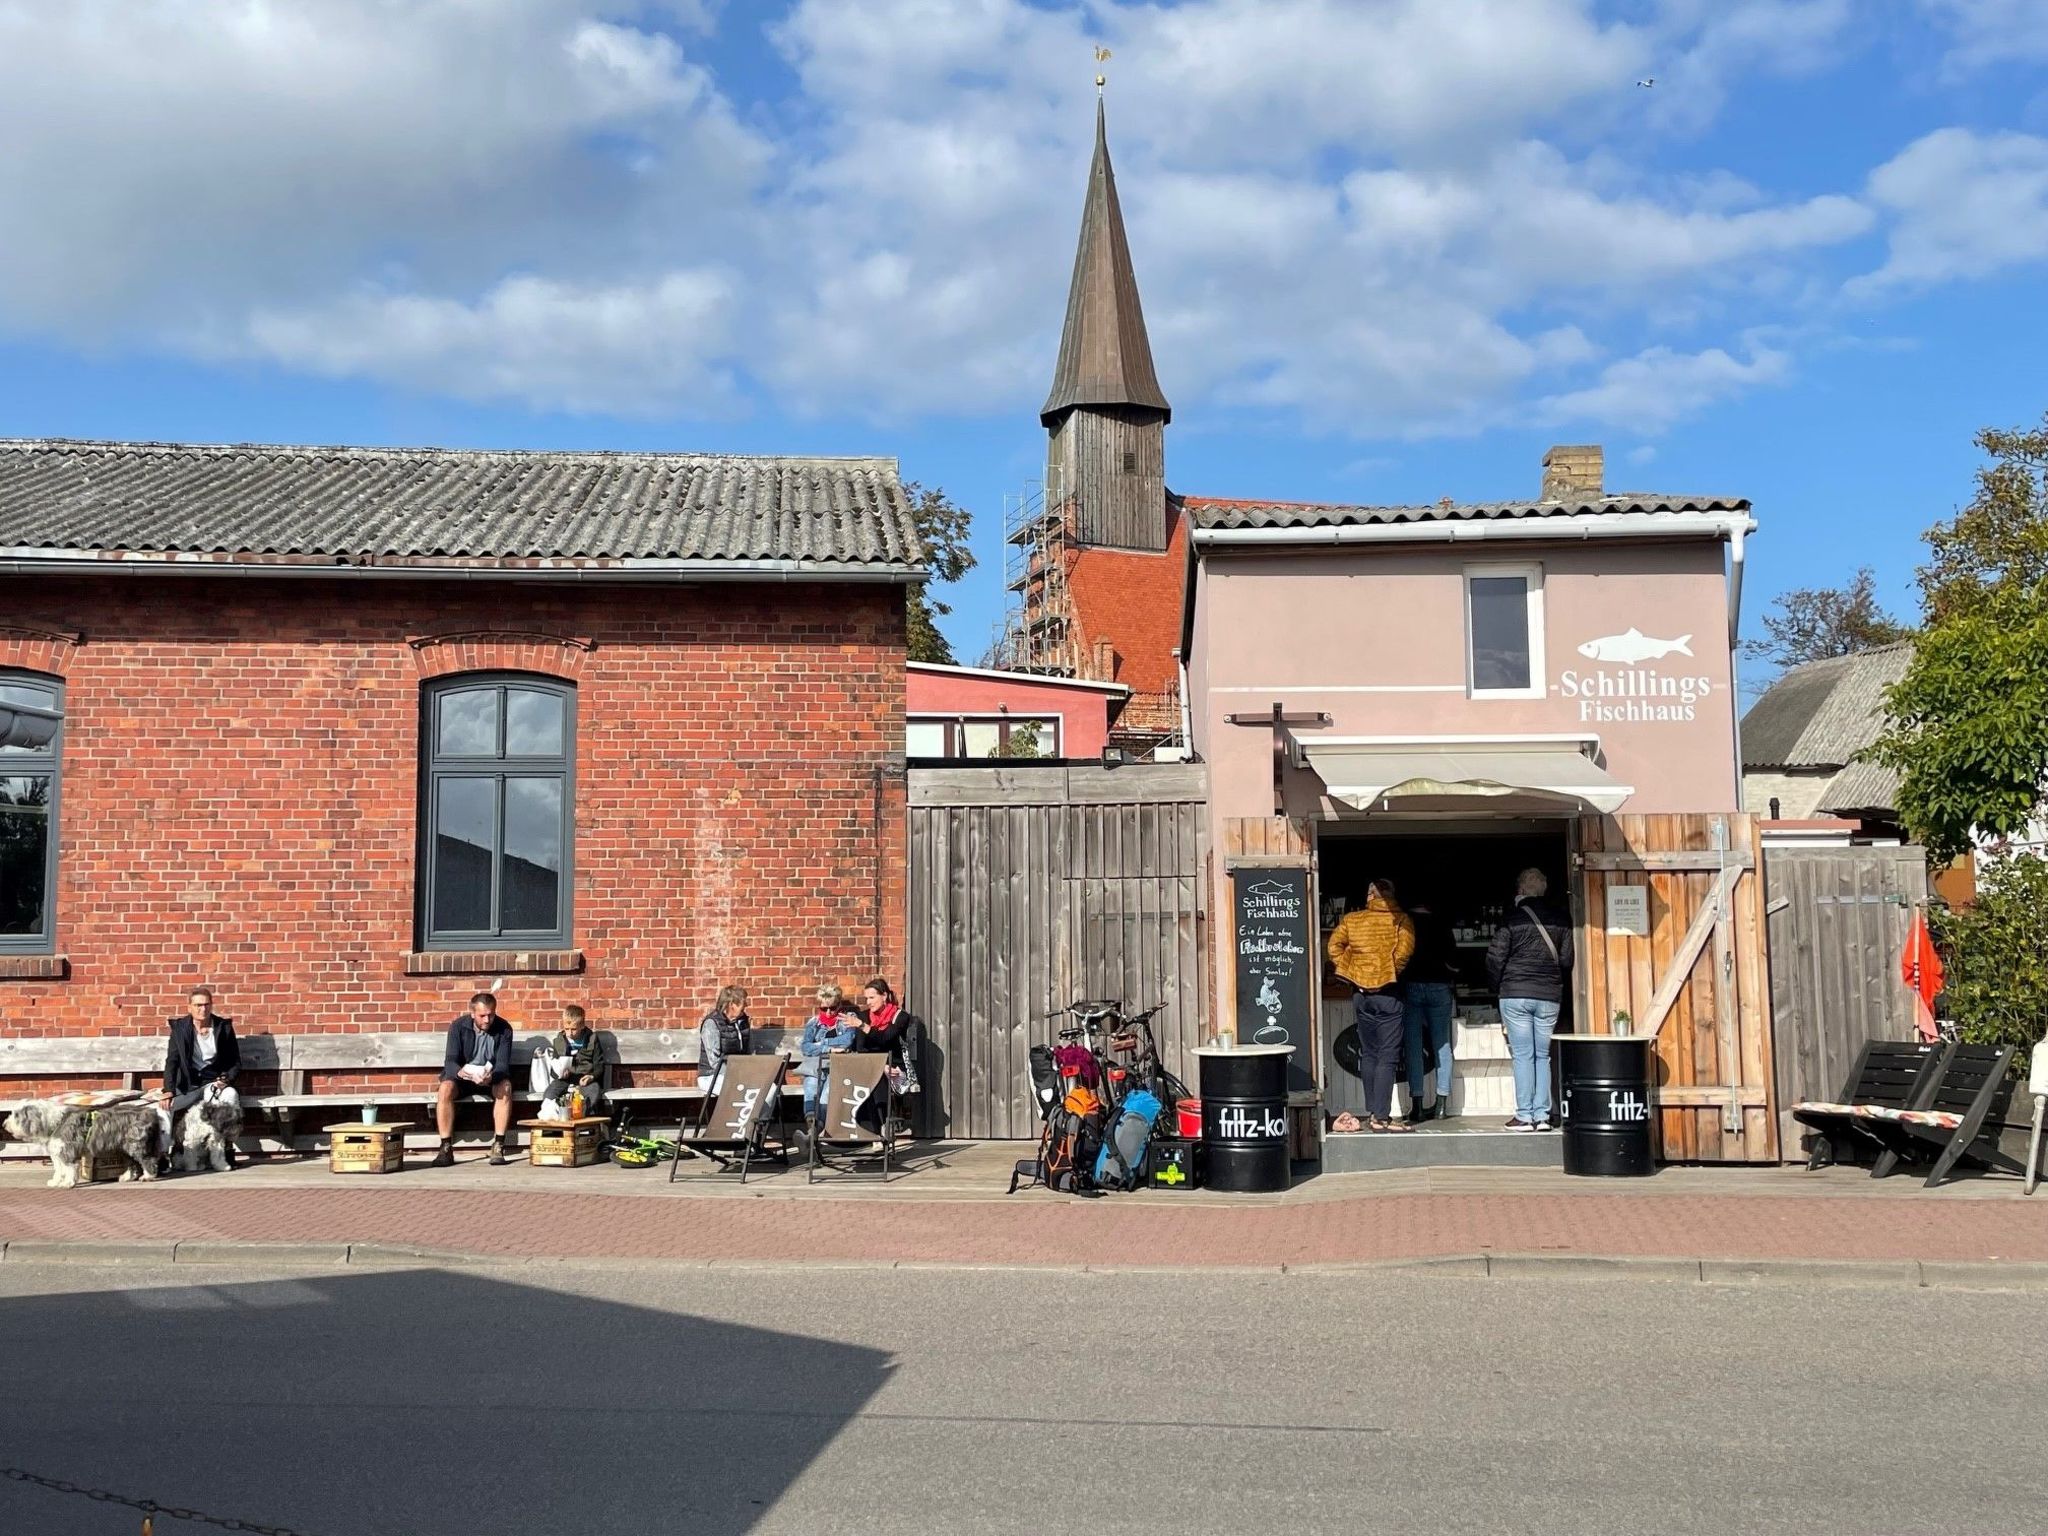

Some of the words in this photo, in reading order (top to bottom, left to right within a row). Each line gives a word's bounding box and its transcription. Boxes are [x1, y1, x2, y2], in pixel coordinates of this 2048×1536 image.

[1561, 671, 1710, 703] Schillings
[1579, 700, 1695, 721] Fischhaus
[1243, 896, 1300, 910] Schillings
[1247, 908, 1298, 918] Fischhaus
[1239, 925, 1254, 935] Ein
